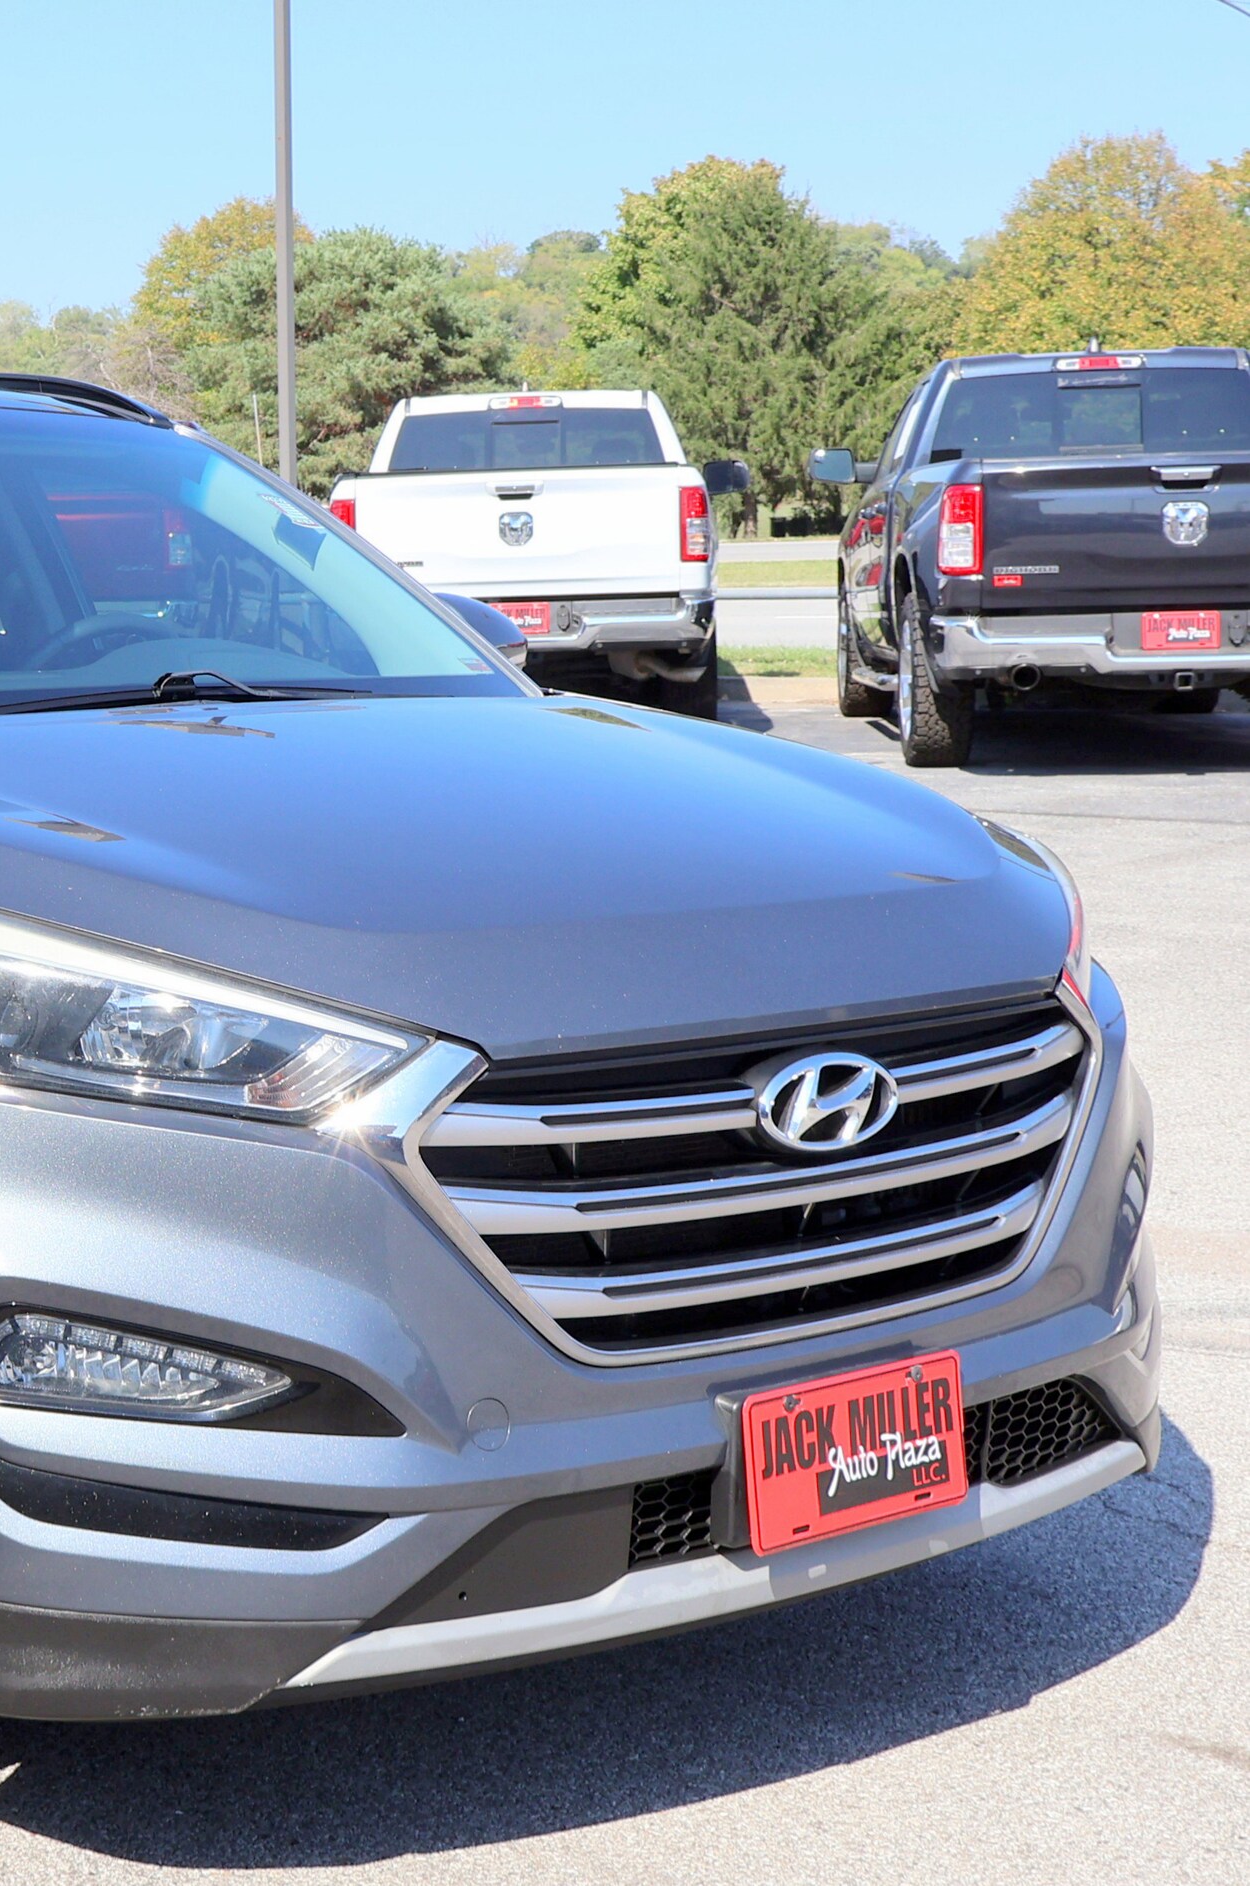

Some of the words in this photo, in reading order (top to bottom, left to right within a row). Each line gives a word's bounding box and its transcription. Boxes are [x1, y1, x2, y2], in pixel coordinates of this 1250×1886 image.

[1147, 617, 1173, 633] JACK
[1177, 616, 1216, 632] MILLER
[761, 1404, 836, 1480] JACK
[847, 1377, 954, 1455] MILLER
[827, 1445, 879, 1497] Auto
[880, 1431, 942, 1481] Plaza
[912, 1462, 946, 1487] LLC.
